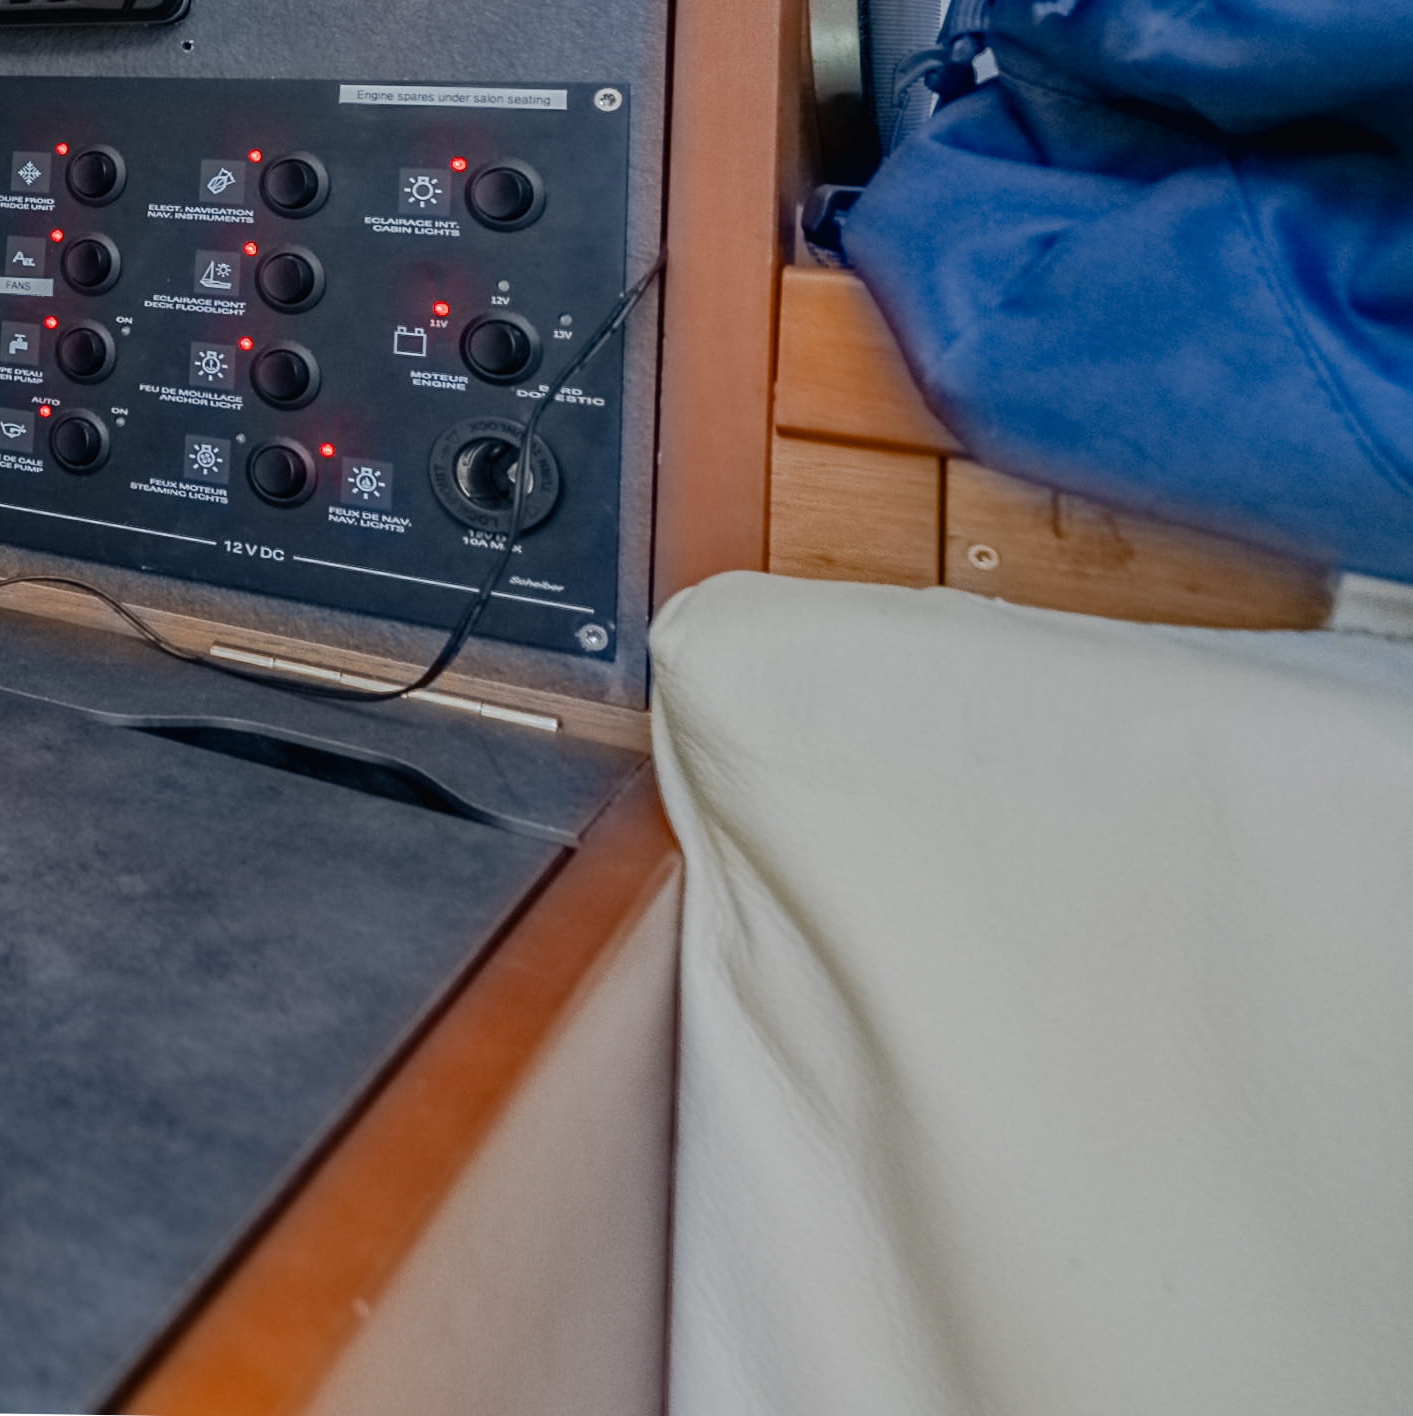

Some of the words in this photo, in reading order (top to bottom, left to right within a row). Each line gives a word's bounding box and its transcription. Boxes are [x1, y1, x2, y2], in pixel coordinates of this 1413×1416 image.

[357, 89, 394, 102] Engine
[398, 92, 434, 102] spares
[438, 92, 470, 103] under
[474, 93, 504, 104] salon
[508, 95, 551, 106] seating
[148, 204, 183, 213] ELECT.
[185, 206, 254, 217] NAVIGATION
[147, 211, 173, 219] NAV.
[175, 213, 254, 224] INSTRUMENTS
[373, 224, 413, 234] CABIN
[415, 227, 460, 237] LIGHTS
[5, 280, 32, 291] FANS
[491, 296, 510, 305] 12V
[144, 301, 174, 309] DECK
[175, 303, 246, 316] FLOODLIGHT
[116, 316, 133, 324] ON
[429, 319, 448, 328] 11V
[14, 375, 43, 384] PUMP
[410, 370, 469, 384] MOTEUR
[412, 379, 466, 391] ENGINE
[539, 385, 583, 396] BRD
[31, 396, 60, 406] AUTO
[159, 394, 208, 406] ANCHOR
[210, 401, 243, 411] LIGHT
[516, 389, 605, 406] DOESTIC
[111, 407, 128, 415] ON
[4, 454, 16, 462] DE
[17, 457, 43, 466] CALE
[14, 463, 43, 473] PUMP
[130, 482, 187, 497] STEAMING
[188, 491, 228, 504] LIGHTS
[150, 478, 177, 489] FEUX
[179, 484, 227, 496] MOTEUR
[328, 506, 360, 518] FEUX
[362, 511, 379, 520] DE
[382, 514, 412, 526] NAV.
[328, 514, 357, 526] NAV.
[360, 520, 404, 533] LIGHTS
